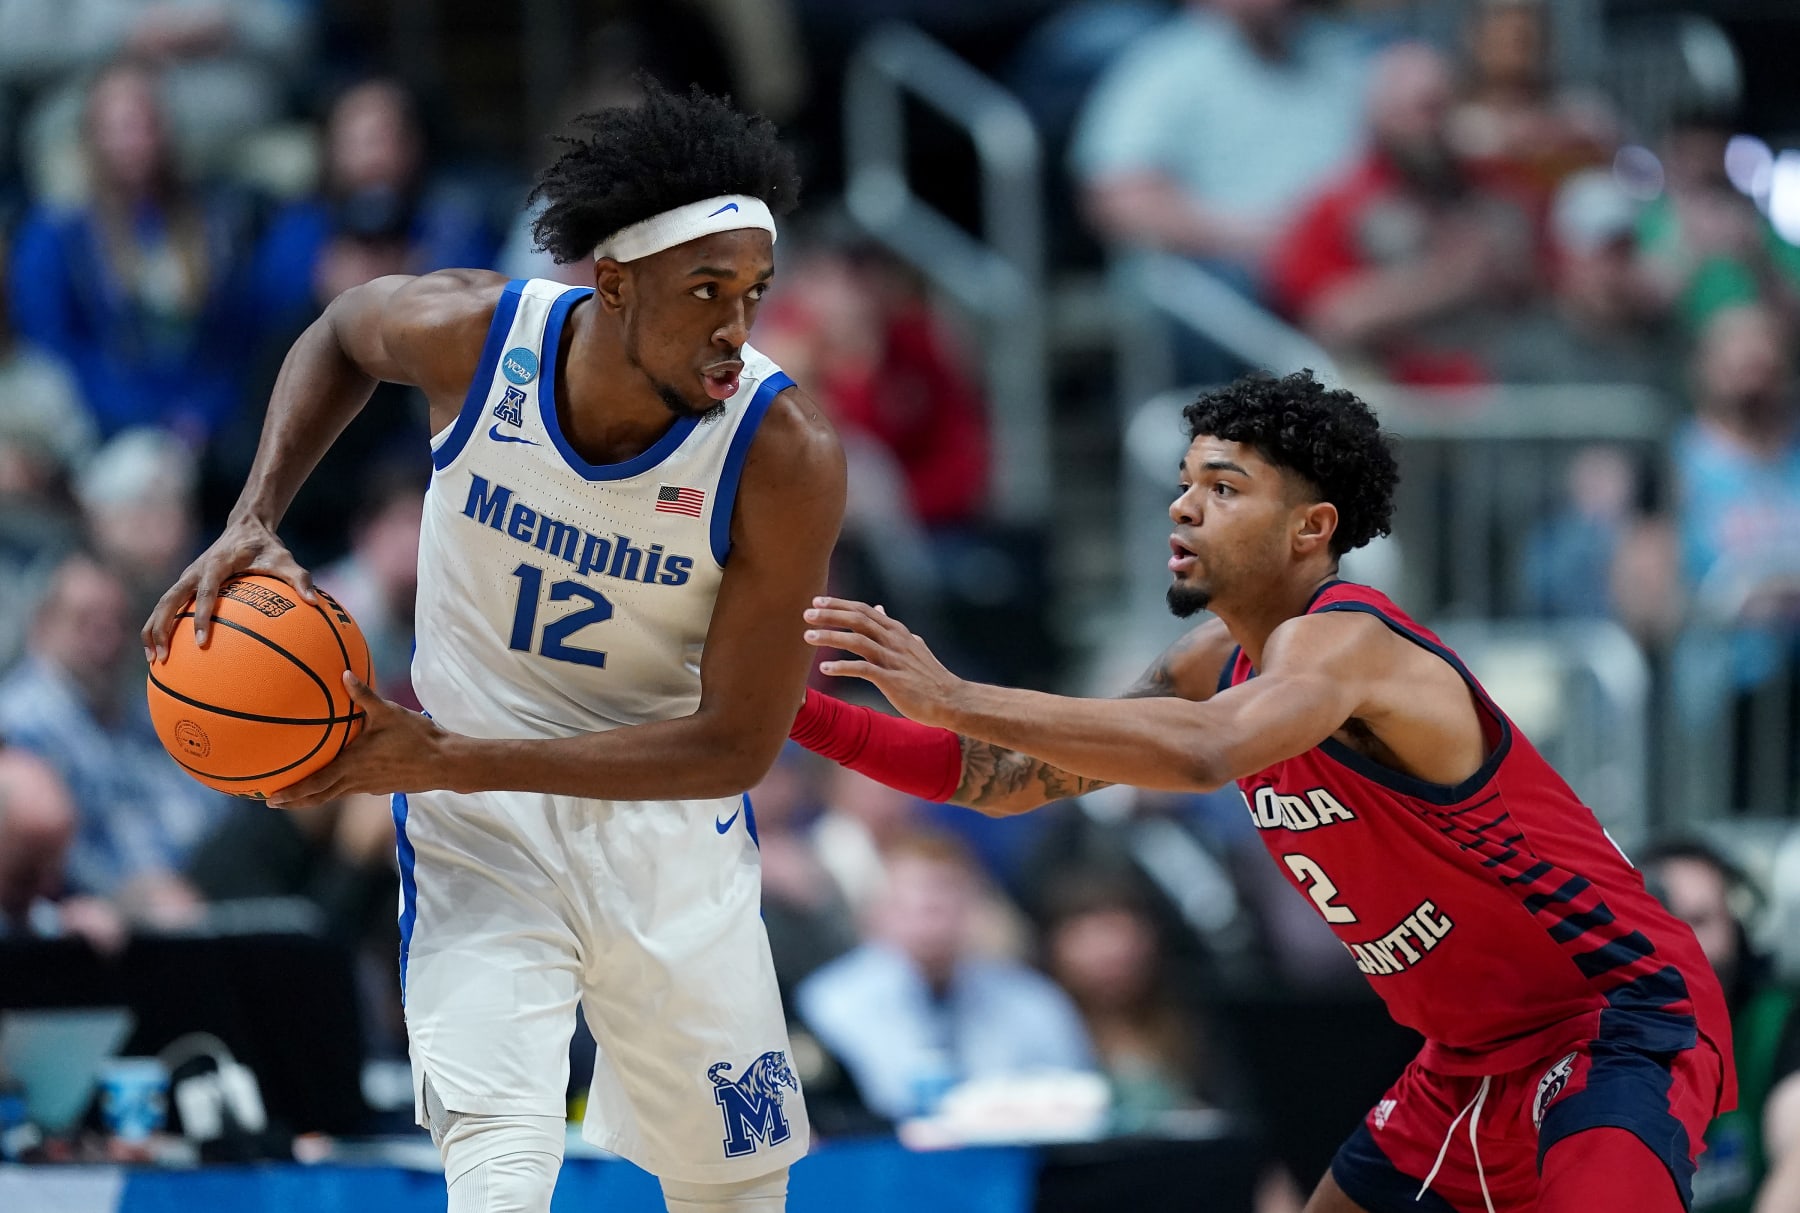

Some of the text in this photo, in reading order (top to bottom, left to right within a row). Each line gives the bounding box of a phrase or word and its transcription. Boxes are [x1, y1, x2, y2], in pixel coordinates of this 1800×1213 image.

[505, 358, 532, 381] NCAA
[460, 470, 695, 586] Memphis
[232, 590, 285, 617] MADNESS
[237, 582, 277, 600] MARCH
[508, 562, 615, 670] 12
[1282, 853, 1359, 924] 2
[713, 1083, 791, 1158] M
